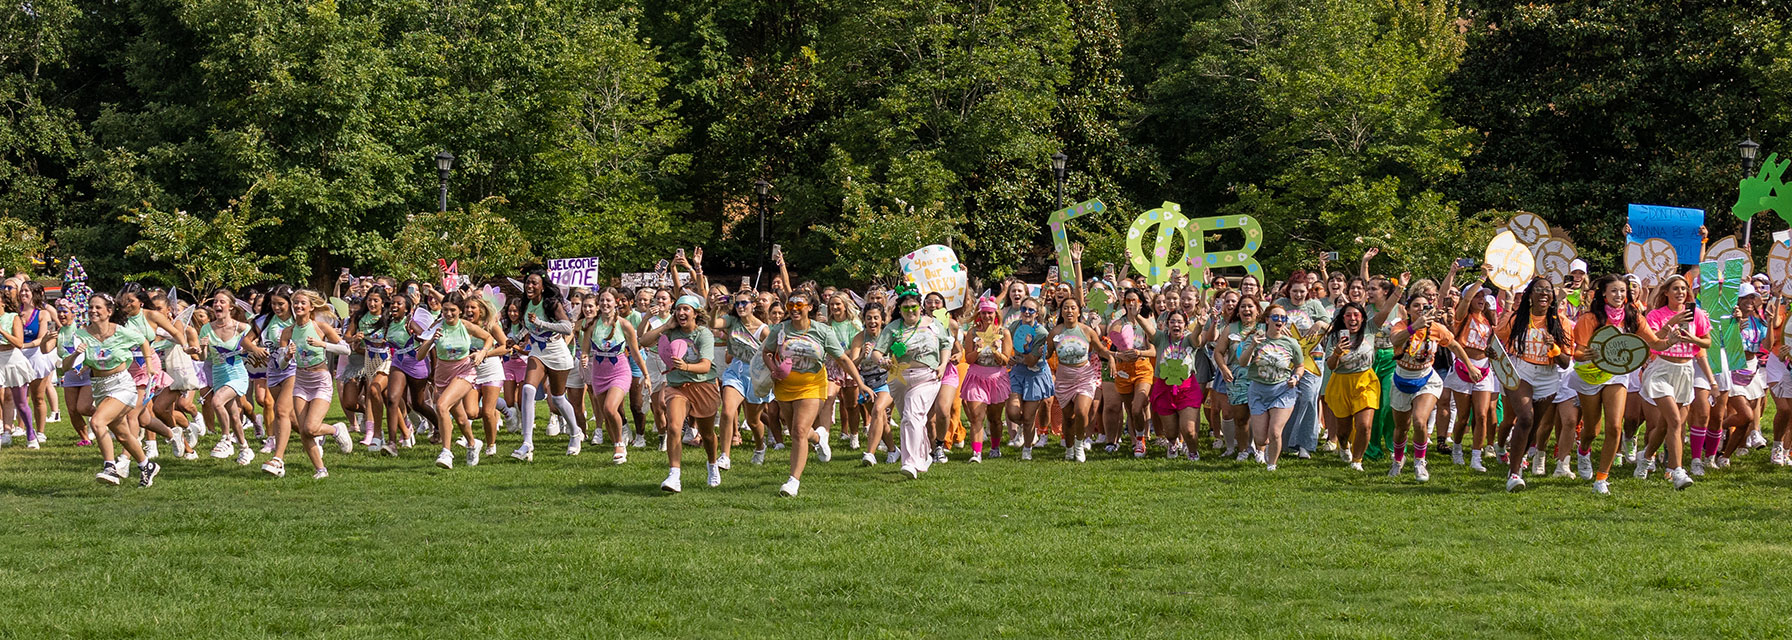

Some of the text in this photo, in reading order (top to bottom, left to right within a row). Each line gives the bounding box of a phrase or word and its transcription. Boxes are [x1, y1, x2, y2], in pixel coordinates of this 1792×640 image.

[1672, 225, 1684, 237] BE
[548, 257, 598, 271] WELCOME
[551, 268, 596, 286] HOME
[920, 276, 956, 294] LUCKY
